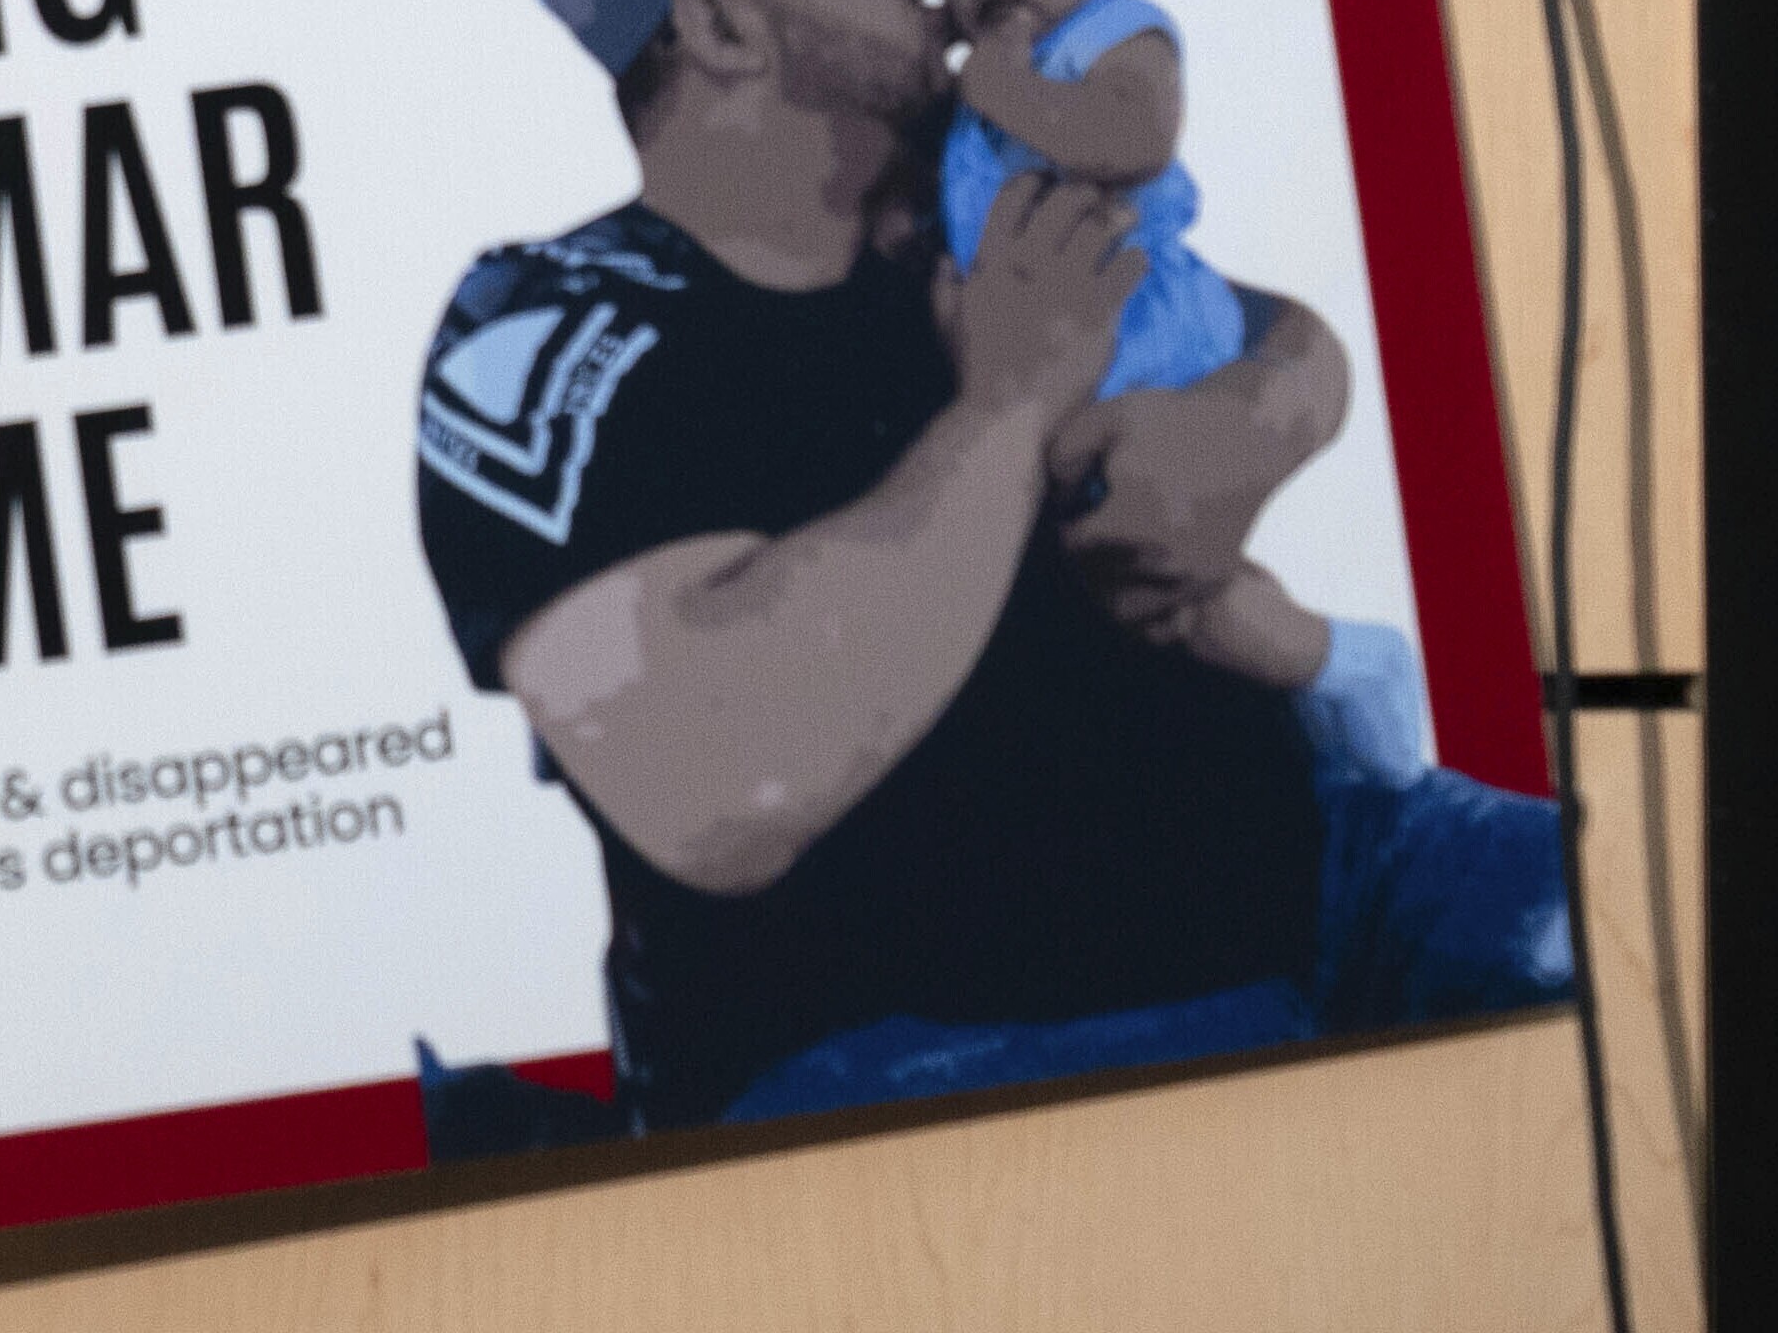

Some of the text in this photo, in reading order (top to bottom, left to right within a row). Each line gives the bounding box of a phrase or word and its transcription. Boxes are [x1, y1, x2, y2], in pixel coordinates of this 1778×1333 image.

[0, 770, 41, 820] &
[61, 712, 454, 812] disappeared
[43, 796, 404, 885] deportation
